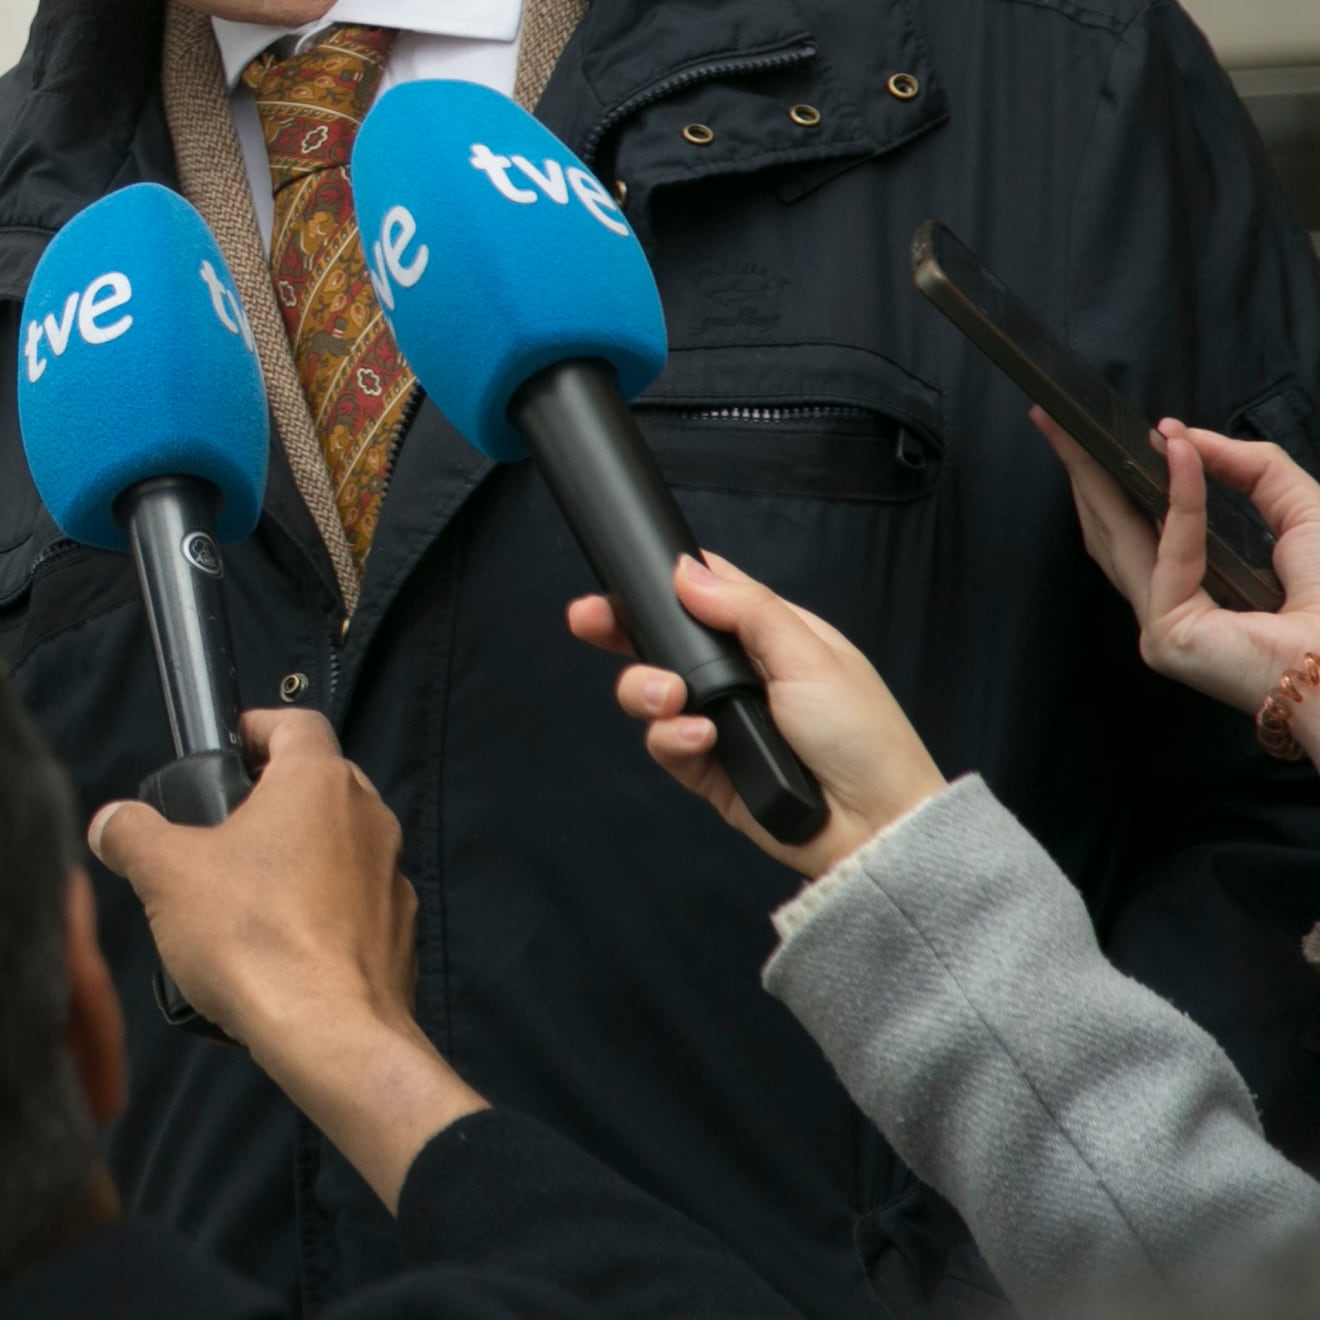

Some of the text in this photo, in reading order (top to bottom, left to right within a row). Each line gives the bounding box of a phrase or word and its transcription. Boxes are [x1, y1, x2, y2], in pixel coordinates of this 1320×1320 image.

[470, 143, 631, 237] tve
[370, 205, 429, 312] ve
[24, 272, 133, 383] tve
